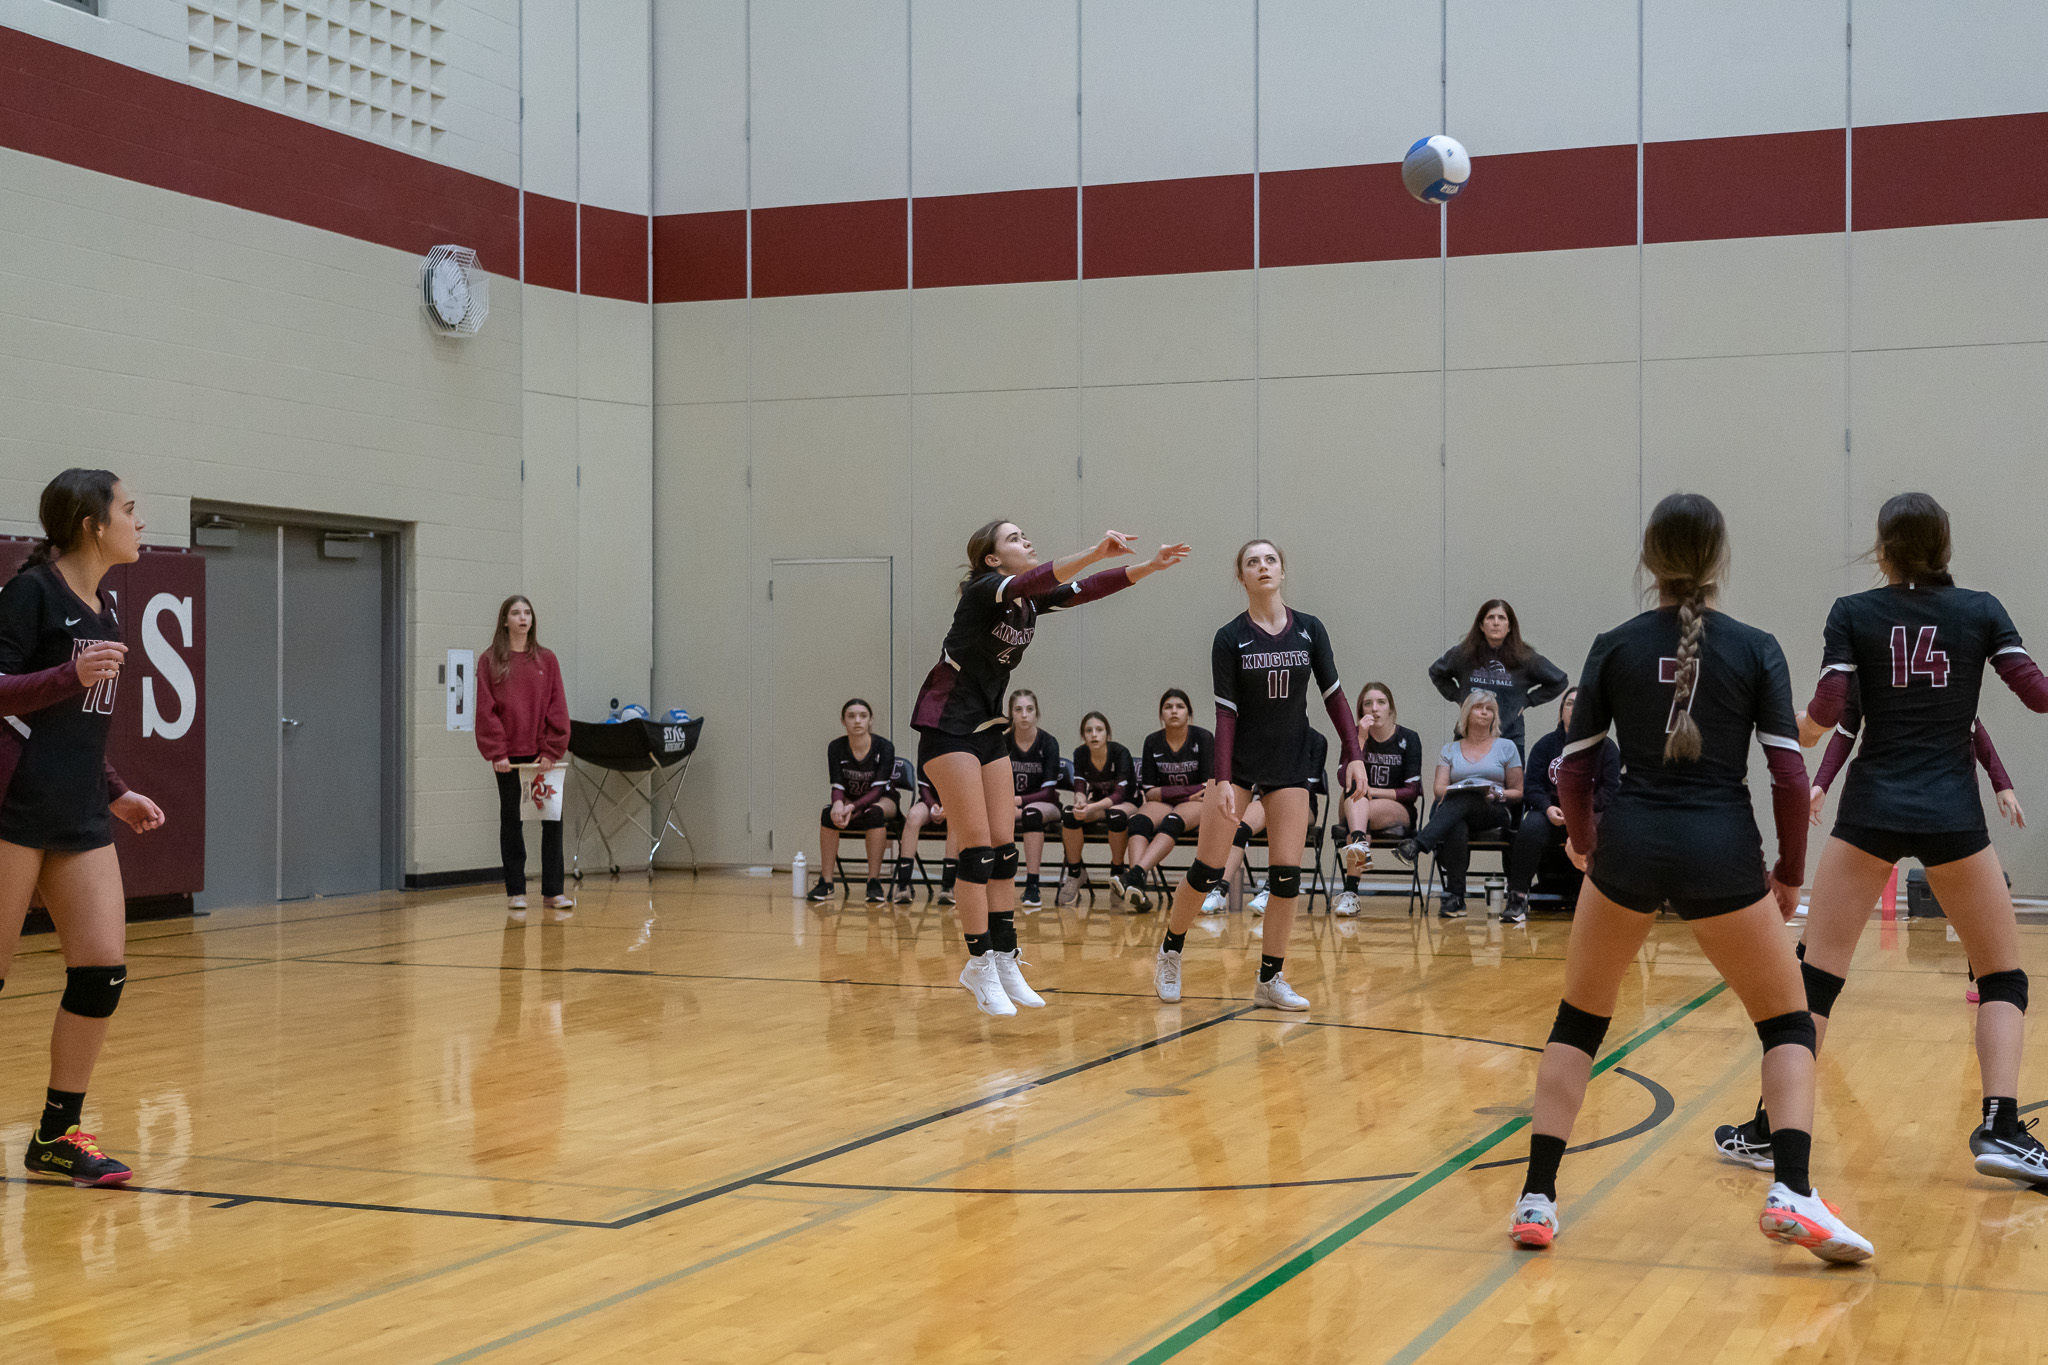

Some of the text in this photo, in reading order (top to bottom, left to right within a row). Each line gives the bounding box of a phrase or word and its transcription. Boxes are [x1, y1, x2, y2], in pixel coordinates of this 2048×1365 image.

[1241, 650, 1310, 669] KNIGHTS
[1889, 625, 1951, 688] 14
[1267, 669, 1290, 699] 11
[1469, 676, 1513, 687] VOLLYBALL
[1658, 657, 1700, 734] 7
[1011, 761, 1043, 774] NIGHTS
[1367, 752, 1403, 766] NIGHTS
[1016, 773, 1028, 792] 8
[1370, 764, 1390, 786] 15
